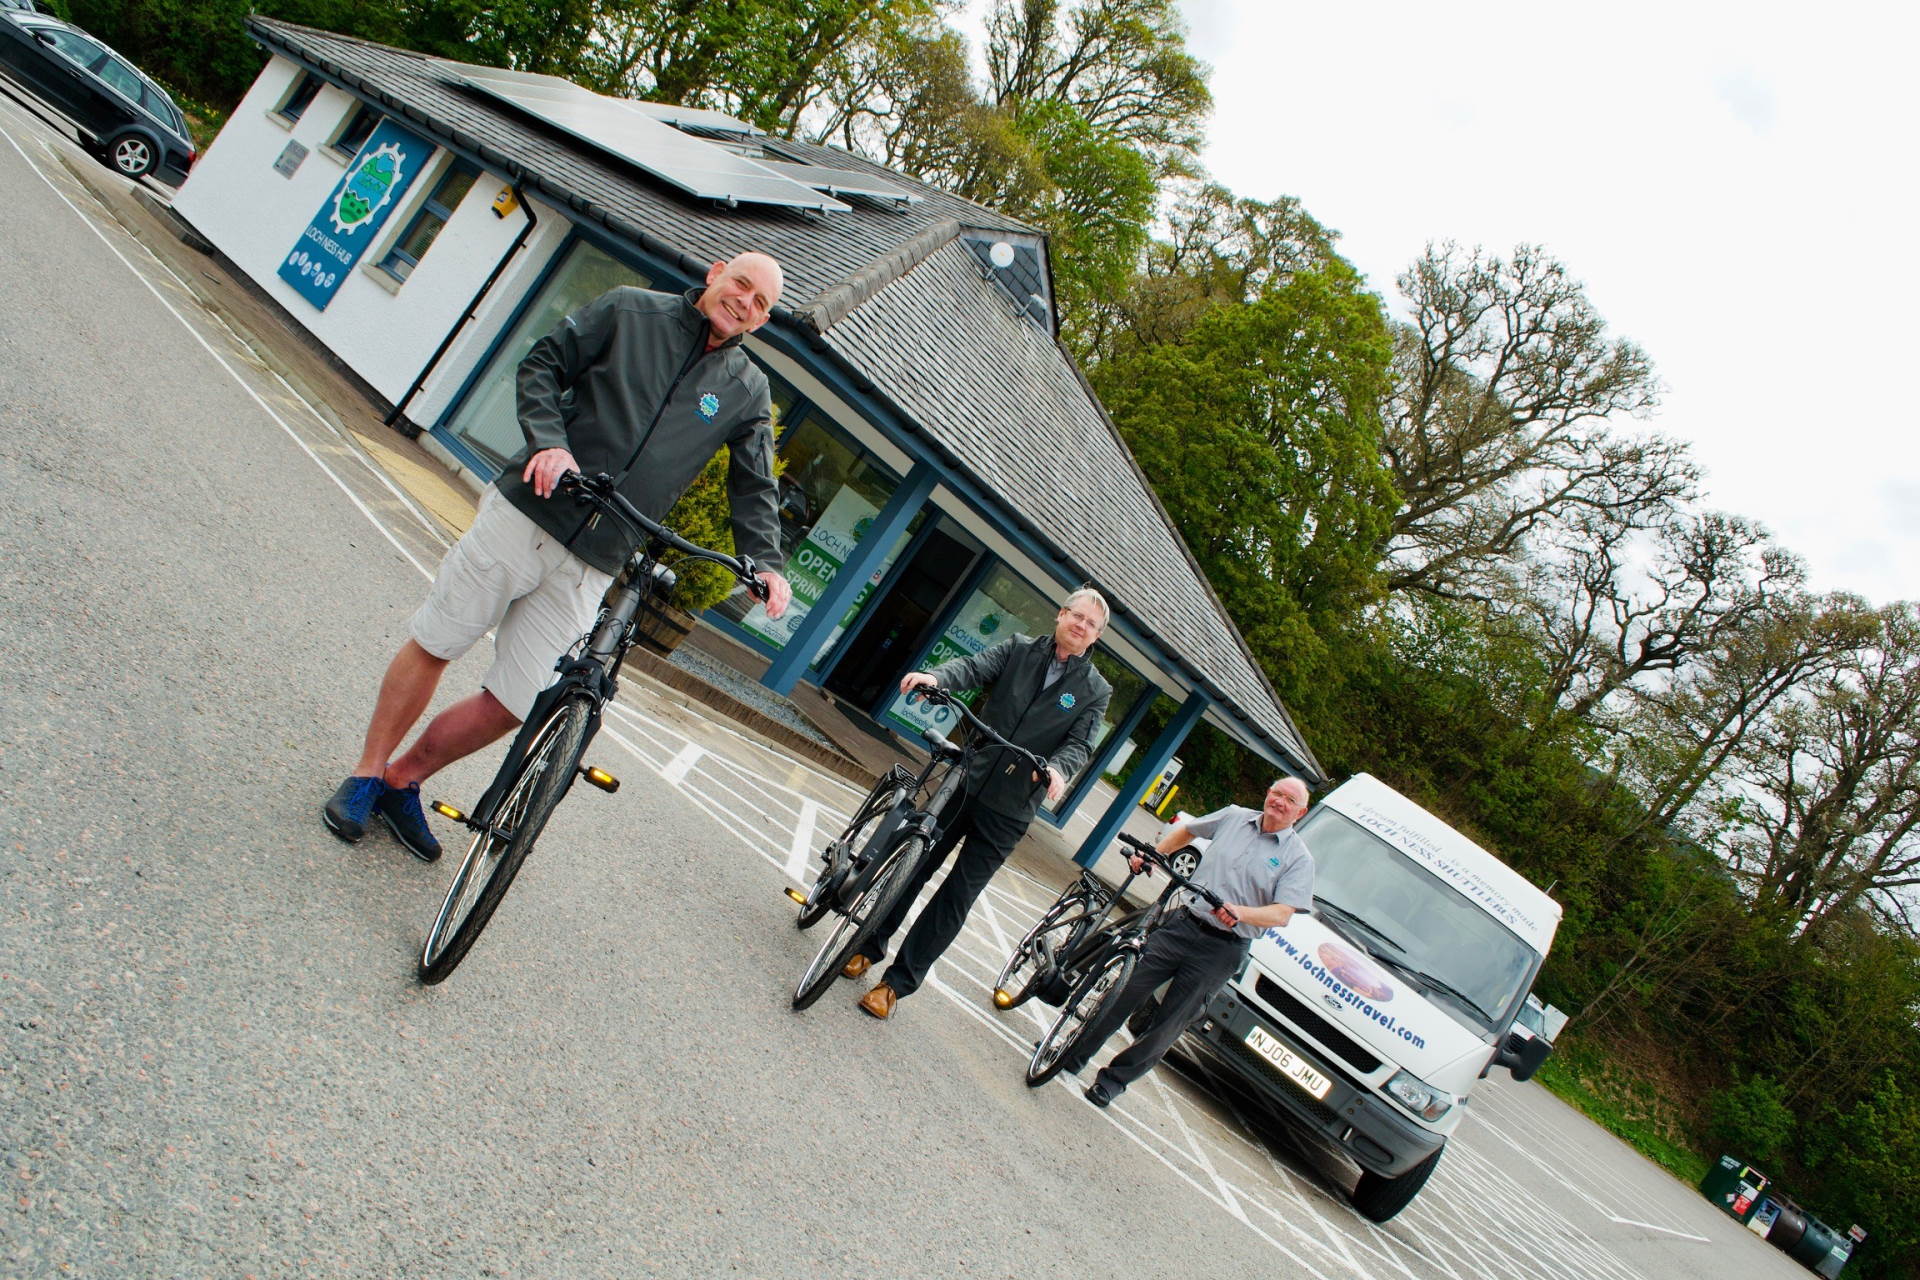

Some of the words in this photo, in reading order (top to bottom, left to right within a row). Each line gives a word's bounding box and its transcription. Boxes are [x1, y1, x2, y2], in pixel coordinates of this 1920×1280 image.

[305, 225, 328, 247] LOCH
[322, 238, 340, 255] NESS
[335, 247, 352, 265] HUB
[813, 526, 842, 551] LOCH
[785, 569, 823, 601] SPRIN
[949, 625, 971, 646] OCH
[1358, 814, 1398, 837] LOCH
[1398, 834, 1434, 860] NESS
[1433, 858, 1518, 925] SHUTTLEBUS
[1265, 927, 1426, 1051] www.lochnesstravel.com
[1253, 1033, 1293, 1068] NJ06
[1292, 1065, 1324, 1091] JMU
